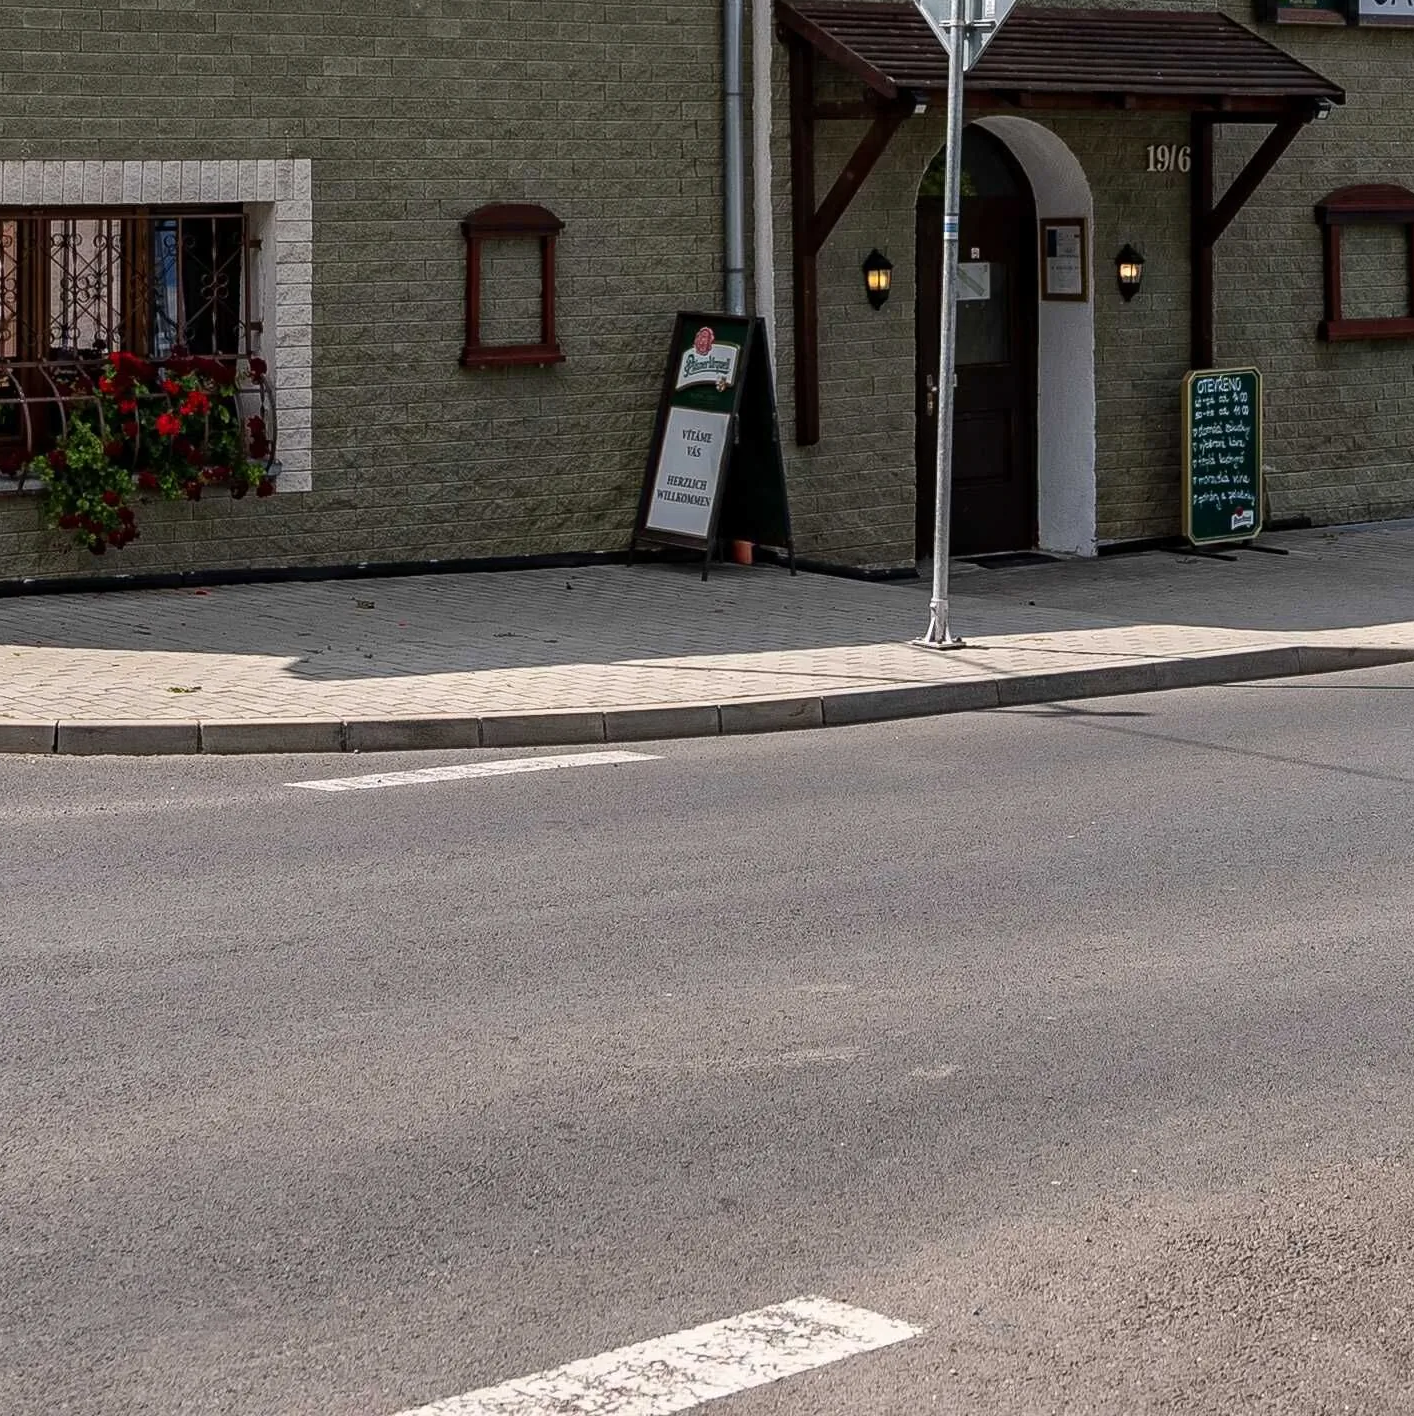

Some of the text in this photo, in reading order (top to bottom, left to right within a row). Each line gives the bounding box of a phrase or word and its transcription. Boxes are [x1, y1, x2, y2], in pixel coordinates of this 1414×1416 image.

[1146, 144, 1192, 173] 19/6
[682, 427, 713, 443] VÍTÁME
[686, 445, 702, 458] VÁS
[666, 475, 707, 491] HERZLICH
[656, 488, 712, 507] WILLKOMMEN
